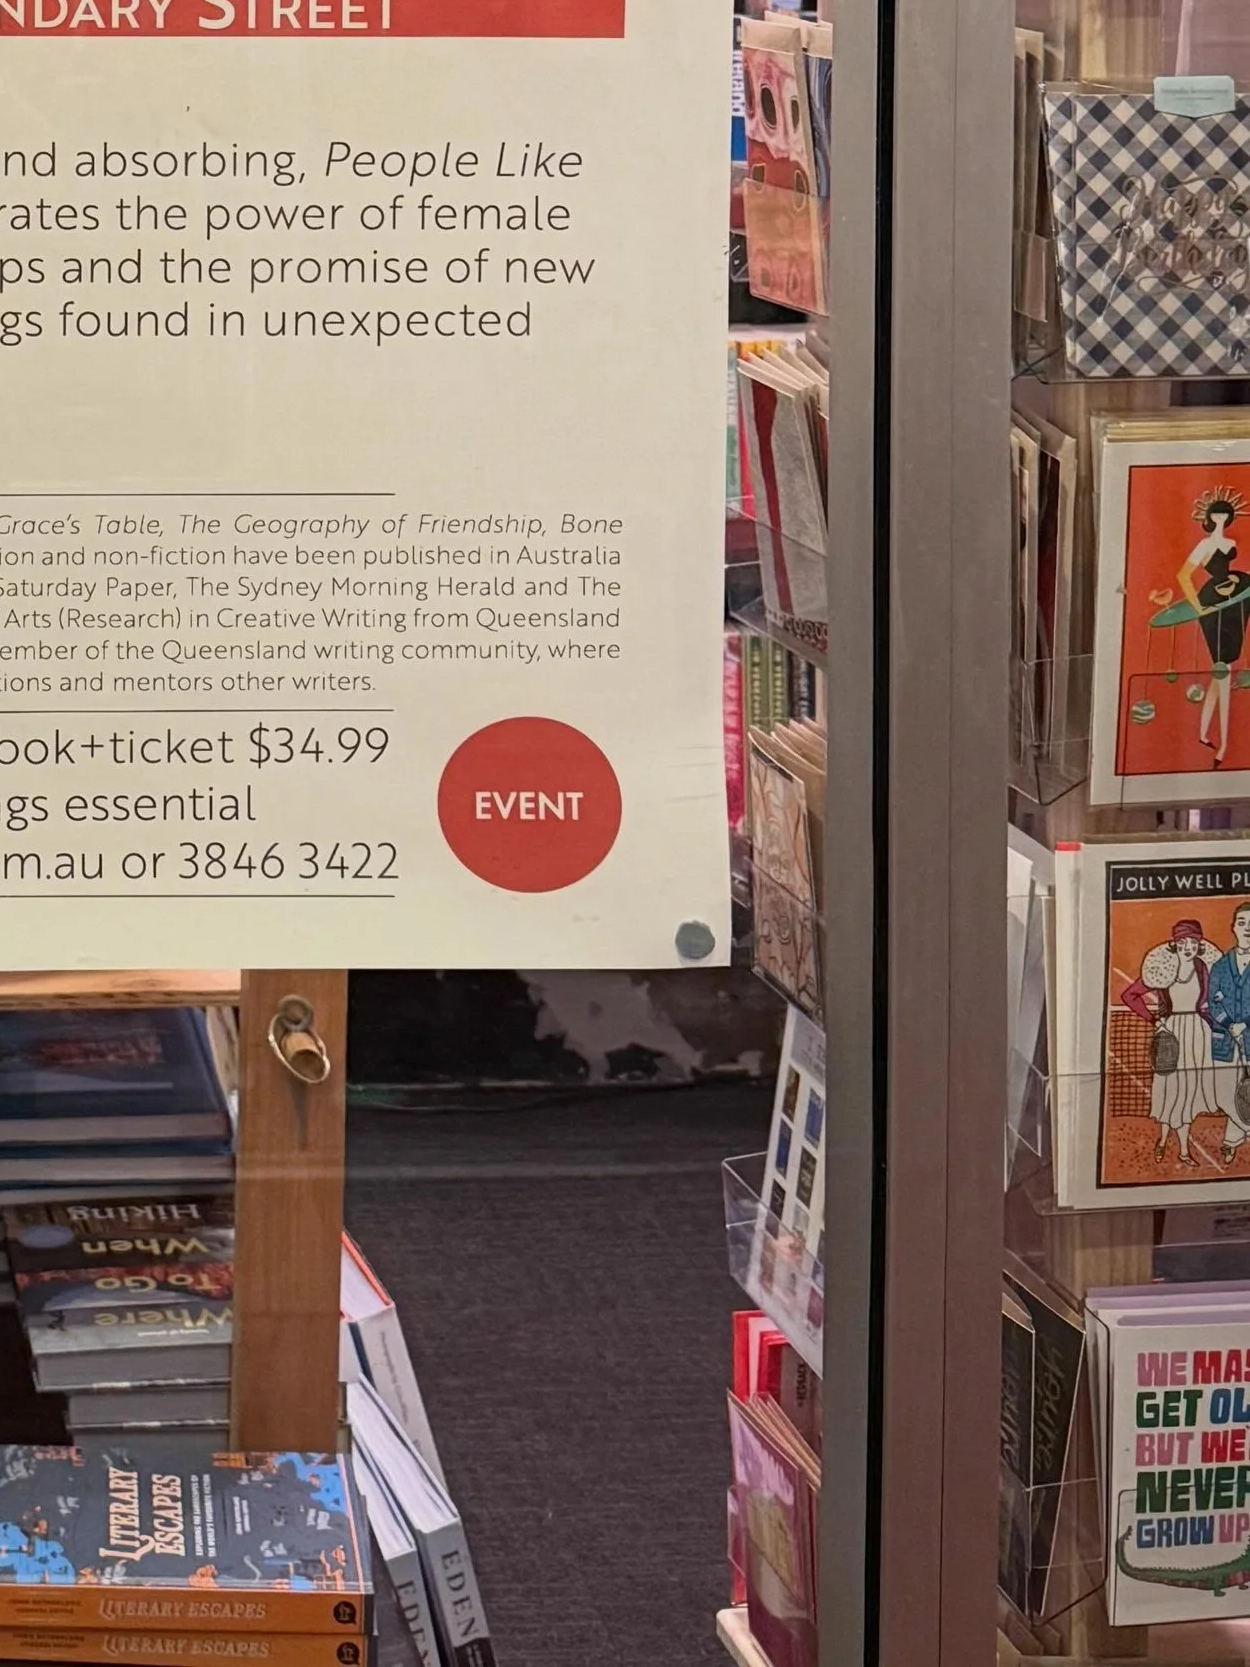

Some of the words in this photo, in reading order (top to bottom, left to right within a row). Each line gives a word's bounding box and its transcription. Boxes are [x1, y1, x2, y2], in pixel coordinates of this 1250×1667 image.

[75, 141, 306, 187] absorbing,
[325, 141, 479, 188] People
[495, 141, 583, 178] Like
[115, 194, 188, 231] the
[206, 204, 345, 241] power
[359, 193, 405, 231] of
[417, 193, 571, 232] female
[61, 248, 142, 285] and
[158, 247, 232, 284] the
[250, 249, 429, 295] promise
[445, 247, 491, 284] of
[505, 257, 596, 285] new
[58, 300, 189, 338] found
[209, 302, 245, 337] in
[264, 300, 531, 347] unexpected
[94, 513, 164, 538] Table,
[178, 514, 221, 535] The
[233, 513, 371, 540] Geography
[381, 513, 409, 539] of
[418, 513, 547, 540] Friendship,
[560, 513, 623, 535] Bone
[41, 545, 85, 567] and
[93, 544, 226, 567] non-fiction
[233, 544, 289, 566] have
[295, 544, 356, 566] been
[363, 544, 481, 571] published
[490, 544, 510, 565] in
[516, 544, 621, 566] Australia
[85, 639, 111, 661] of
[114, 639, 155, 661] the
[161, 638, 306, 665] Queensland
[313, 640, 395, 665] writing
[401, 639, 541, 665] community,
[547, 638, 621, 660] where
[59, 670, 104, 692] and
[113, 672, 214, 692] mentors
[220, 670, 286, 692] other
[291, 672, 377, 692] writers.
[249, 721, 389, 770] $34.99
[64, 784, 257, 822] essential
[475, 791, 584, 821] EVENT
[121, 852, 166, 880] or
[178, 841, 285, 880] 3846
[298, 841, 400, 880] 3422
[1116, 875, 1170, 893] JOLLY
[1174, 873, 1224, 890] WELL
[66, 1203, 201, 1223] Hiking
[81, 1236, 209, 1256] When
[94, 1274, 158, 1294] Go
[167, 1272, 222, 1290] To
[1136, 1350, 1187, 1387] WE
[1192, 1348, 1250, 1385] MA
[1135, 1389, 1204, 1429] GET
[1134, 1431, 1195, 1467] BUT
[98, 1466, 156, 1562] LITERARY
[151, 1473, 187, 1557] ESCAPES
[1136, 1514, 1215, 1549] GROW
[97, 1596, 182, 1621] LITERARY
[187, 1597, 268, 1620] ESCAPES
[440, 1548, 480, 1640] EDEN
[190, 1636, 272, 1658] ESCAPES
